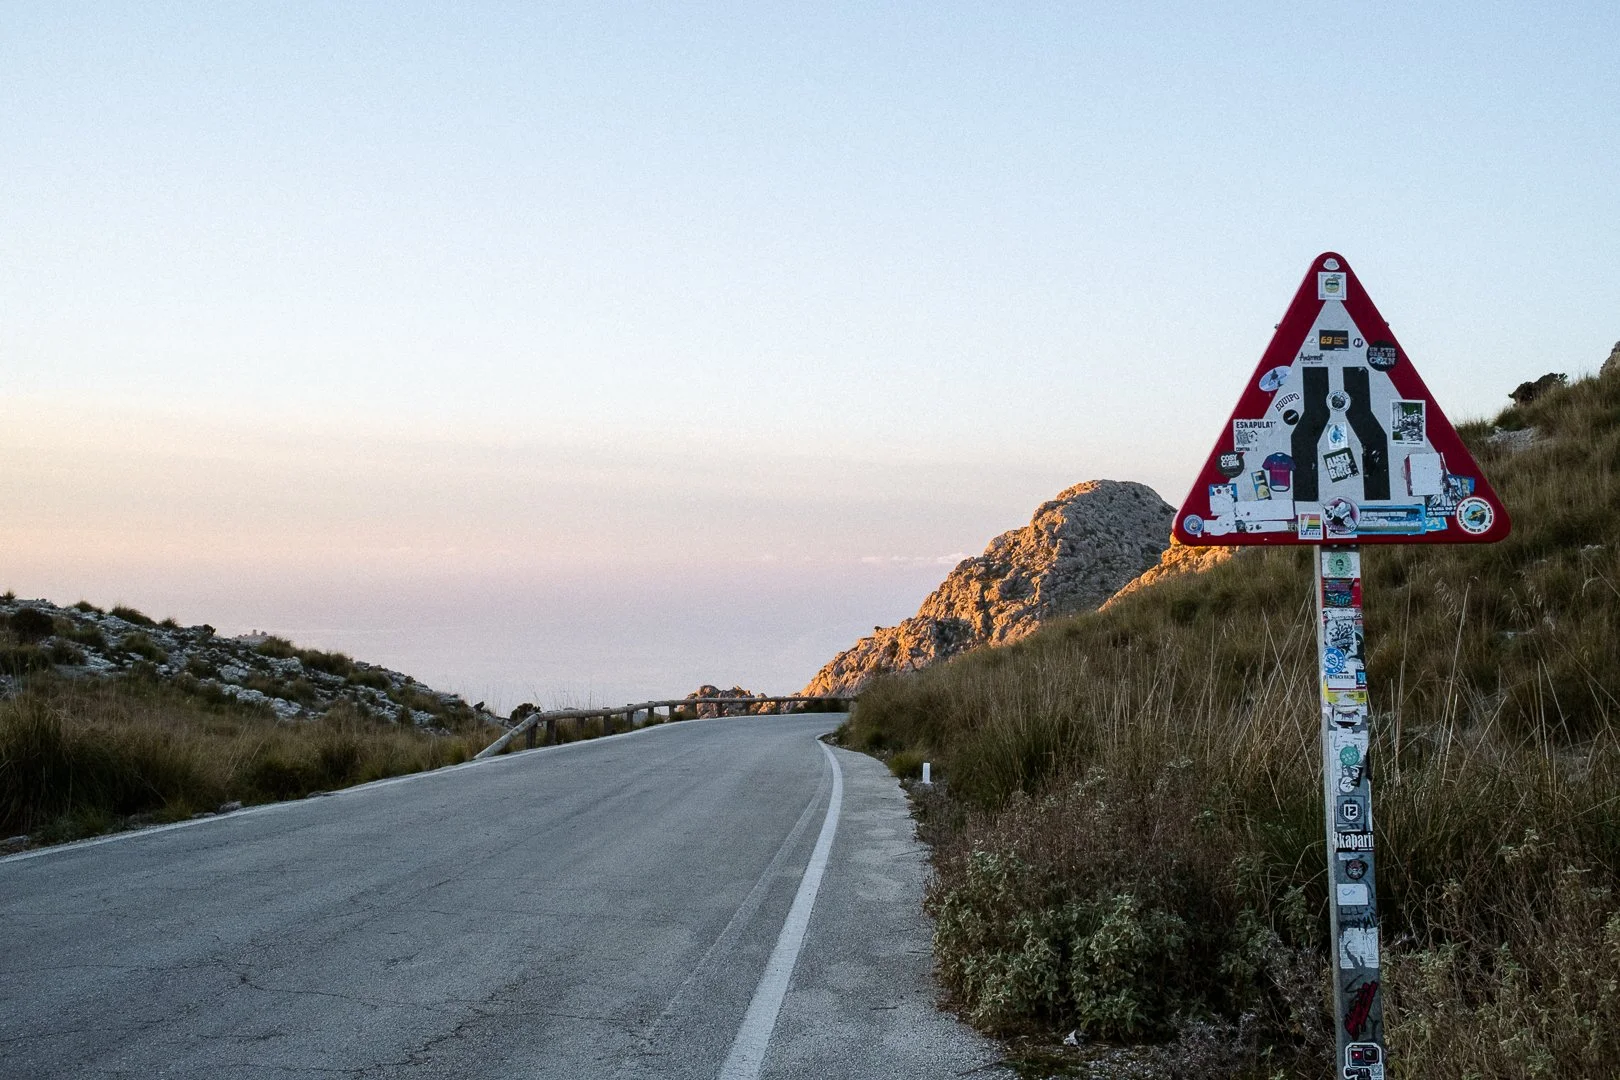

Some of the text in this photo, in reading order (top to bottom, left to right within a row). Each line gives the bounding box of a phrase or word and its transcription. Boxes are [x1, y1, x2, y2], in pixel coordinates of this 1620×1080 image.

[1320, 335, 1333, 345] 69
[1275, 392, 1300, 412] EQUIPO
[1235, 421, 1277, 429] ESKAPULAT
[1220, 453, 1238, 461] COSY
[1345, 805, 1357, 817] 12
